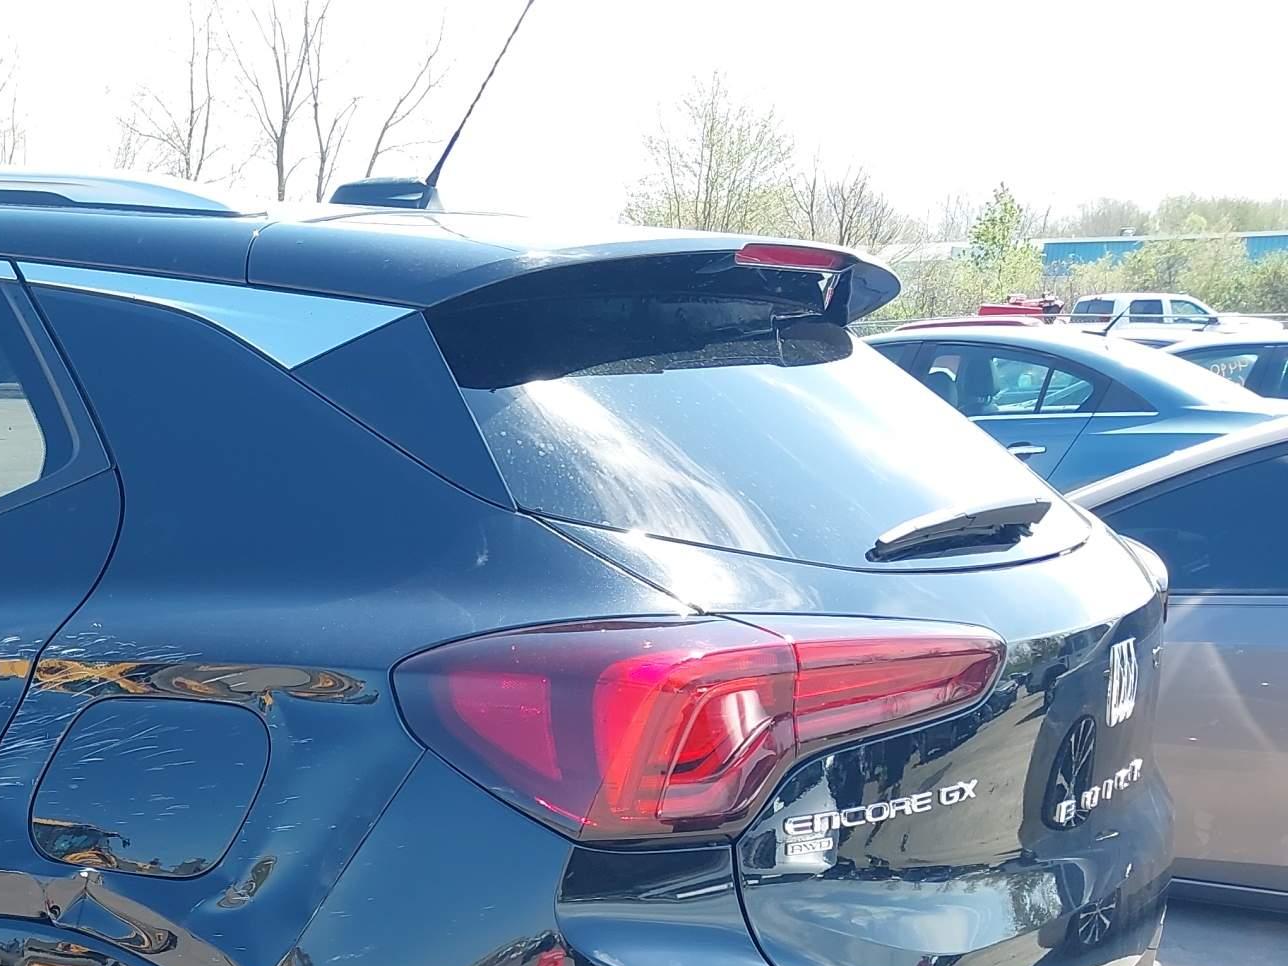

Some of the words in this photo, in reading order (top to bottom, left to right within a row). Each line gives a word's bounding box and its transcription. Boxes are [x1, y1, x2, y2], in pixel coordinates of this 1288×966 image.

[784, 791, 933, 836] ENCORE
[938, 779, 978, 806] GX
[790, 838, 832, 855] AWD
